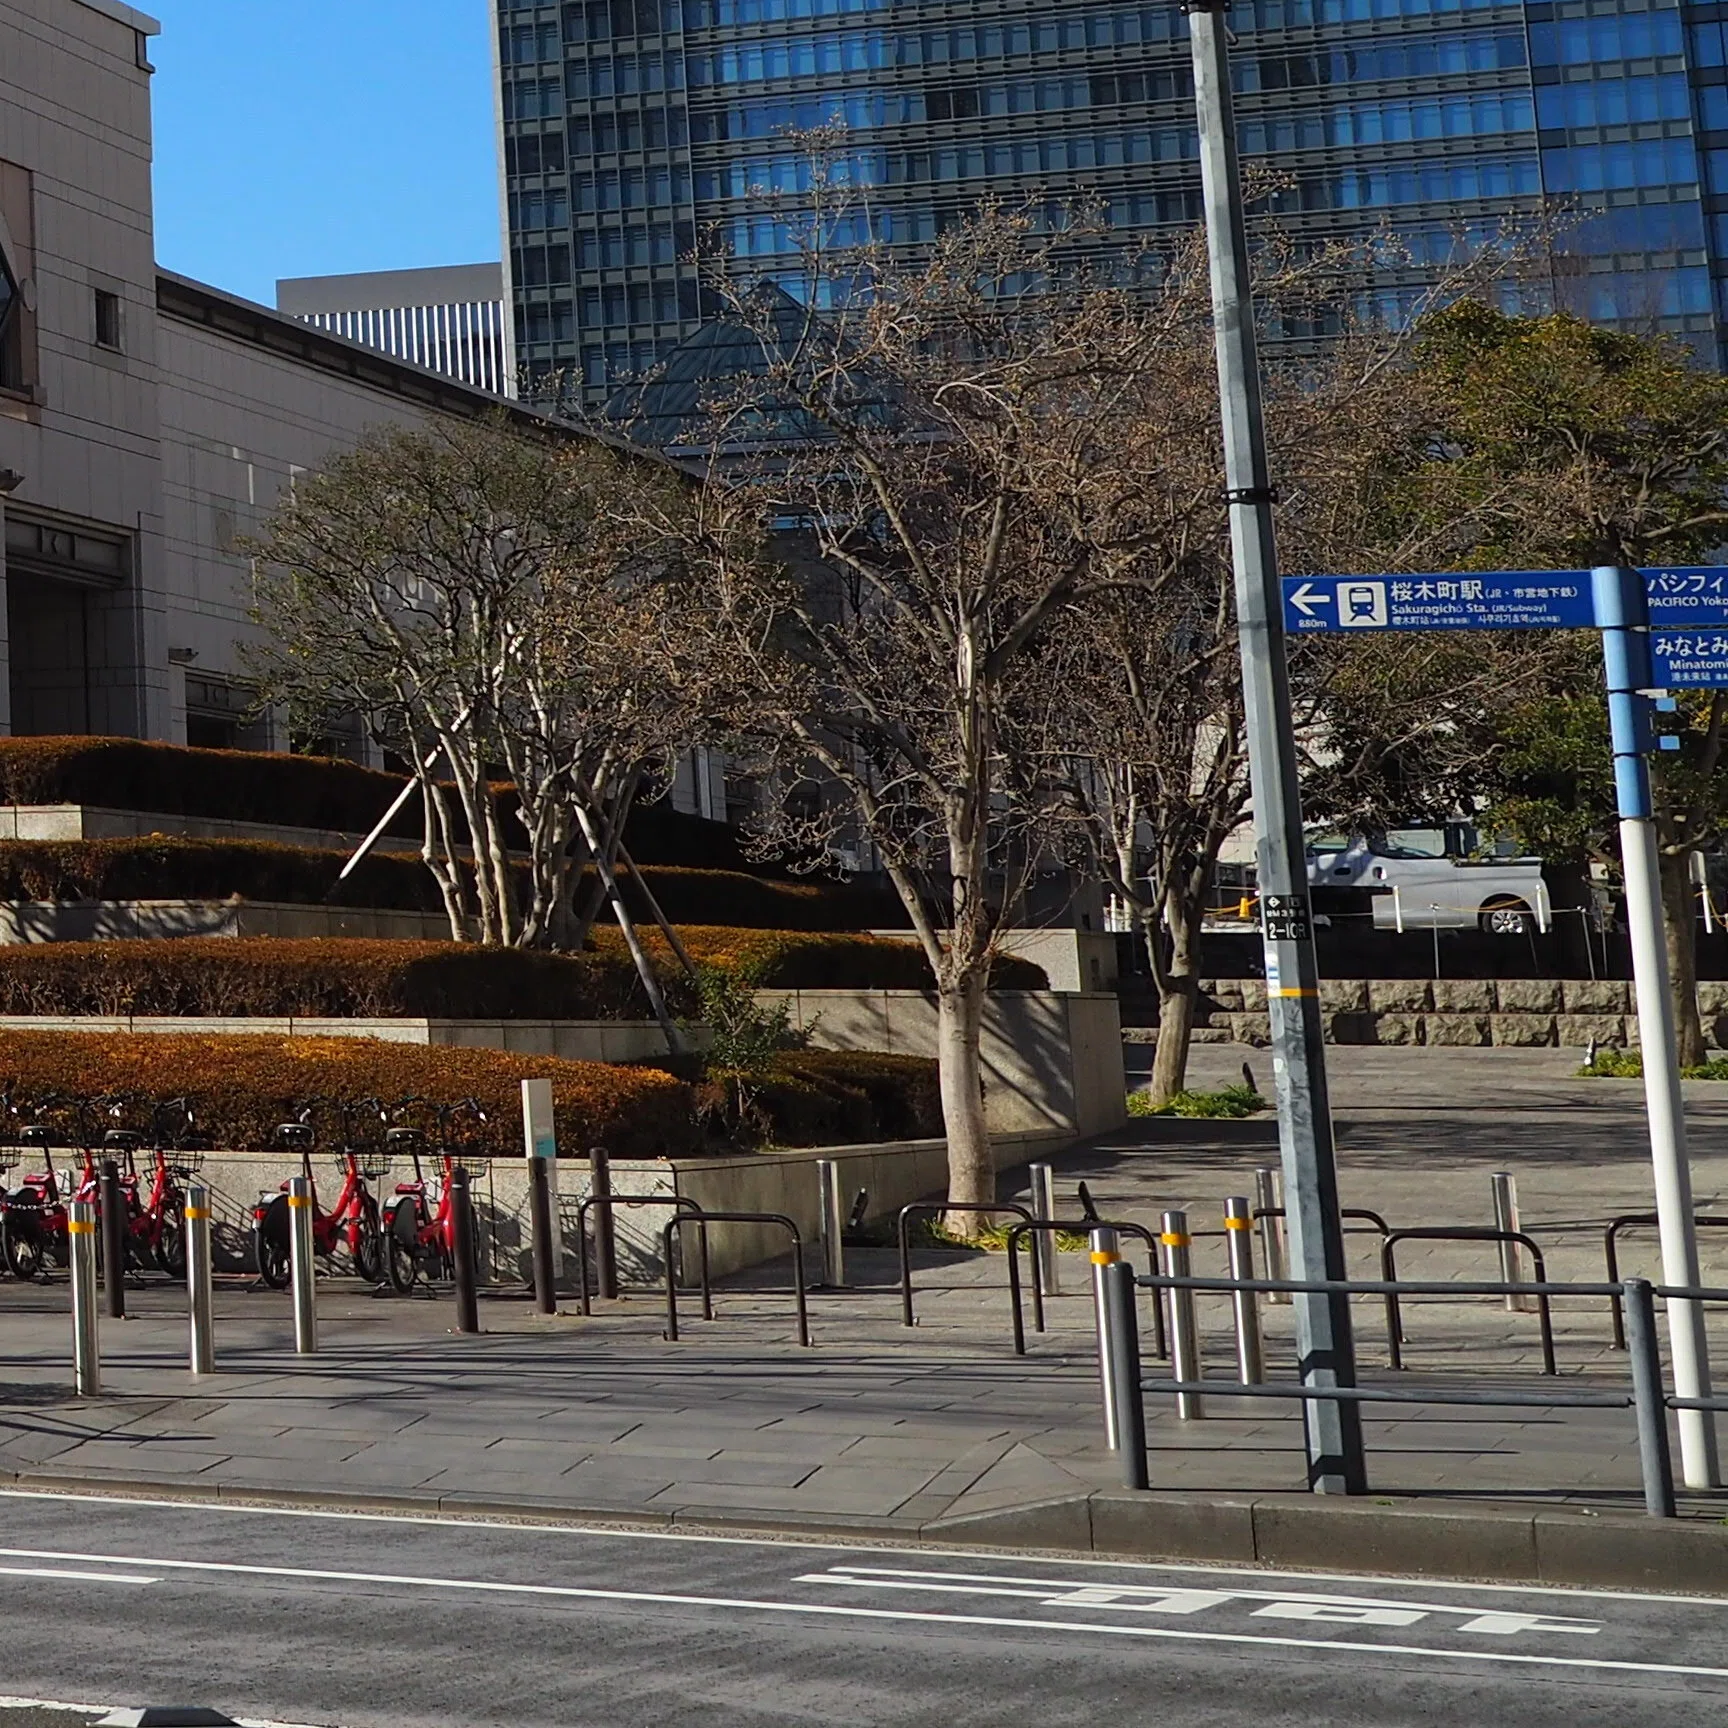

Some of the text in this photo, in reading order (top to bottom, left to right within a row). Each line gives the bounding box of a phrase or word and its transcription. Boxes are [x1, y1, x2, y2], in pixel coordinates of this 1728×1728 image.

[1390, 580, 1484, 602] 桜木町駅
[1647, 573, 1724, 593] パシフィ
[1648, 597, 1699, 607] PACIFICO
